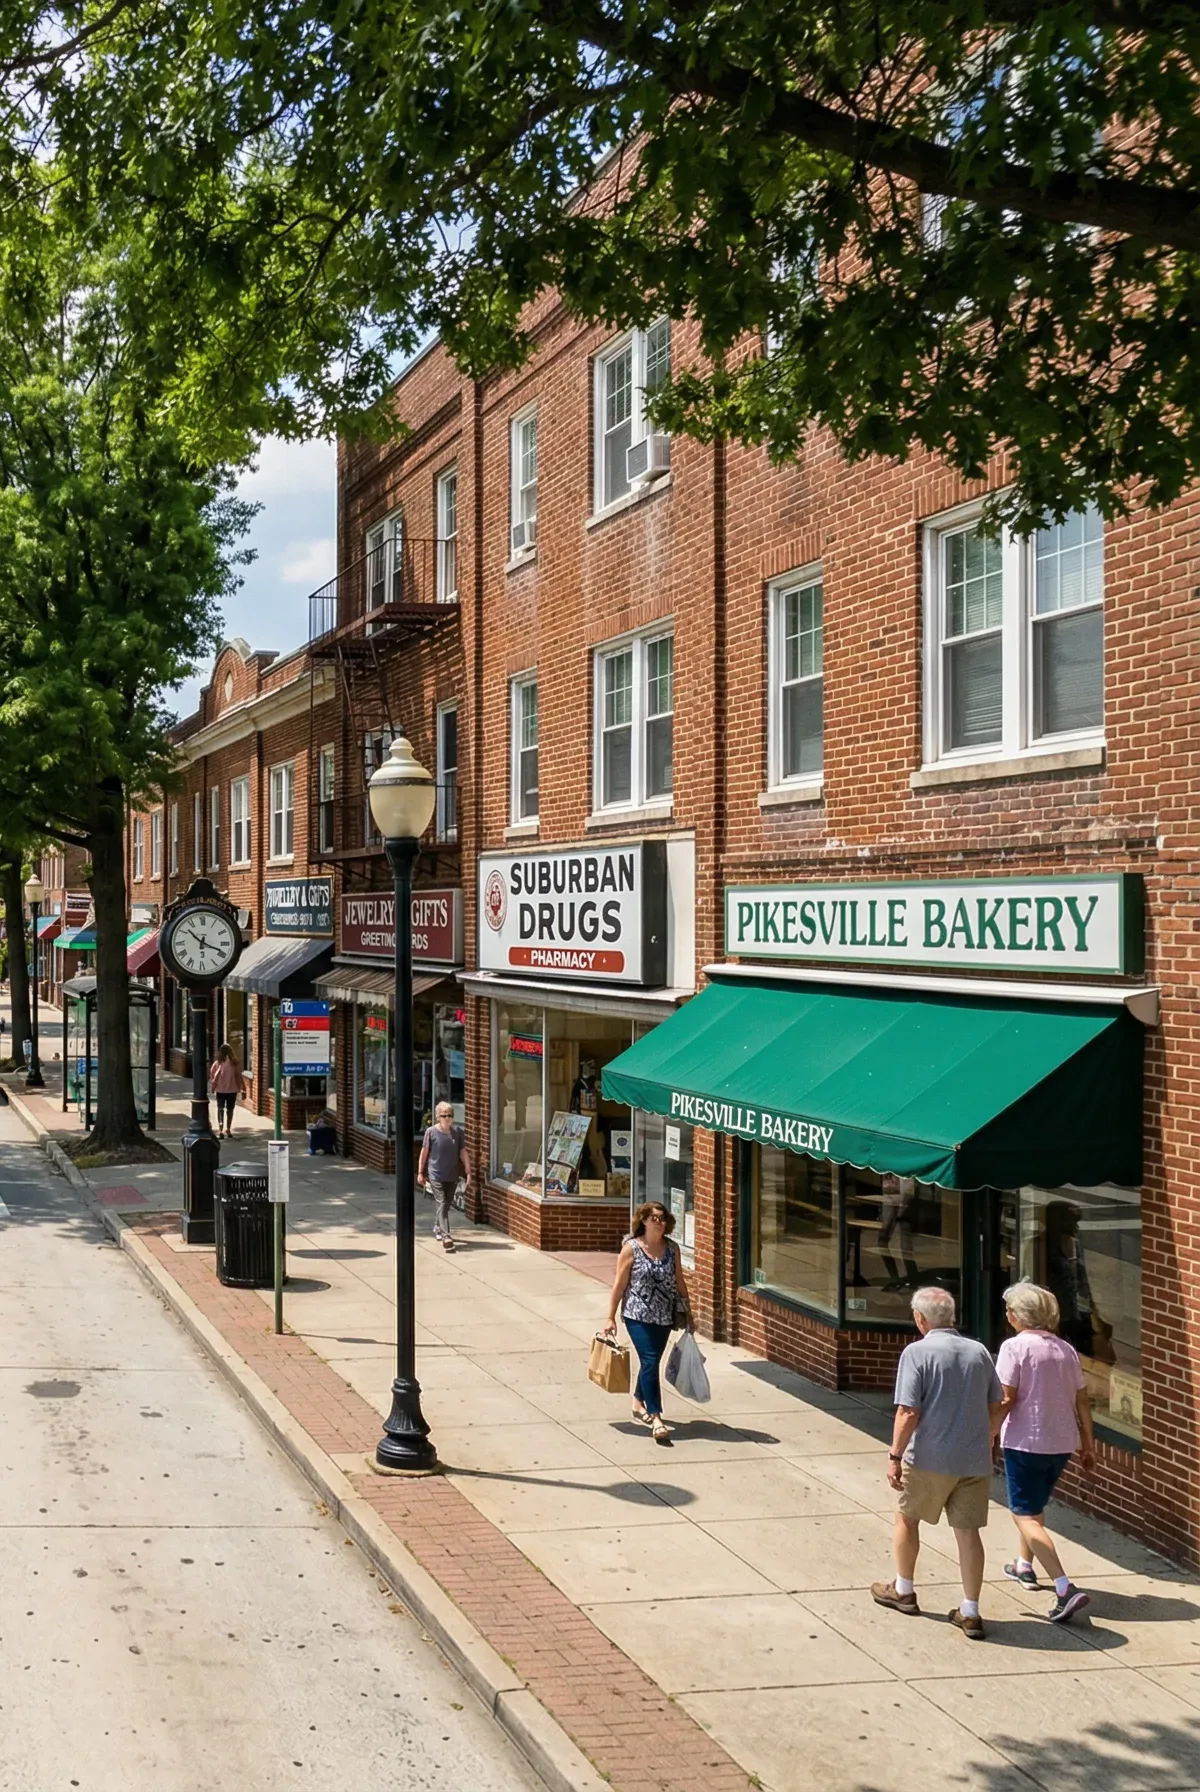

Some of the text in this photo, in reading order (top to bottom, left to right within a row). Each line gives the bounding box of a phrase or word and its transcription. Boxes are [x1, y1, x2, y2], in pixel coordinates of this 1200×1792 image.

[510, 853, 634, 895] SUBURBAN
[345, 900, 395, 926] JEWELRY
[411, 898, 448, 928] GIFTS
[519, 900, 622, 942] DRUGS
[737, 895, 1098, 952] PIKESVILLE BAKERY
[531, 949, 596, 968] PHARMACY
[671, 1091, 834, 1153] PIKESVILLE BAKERY
